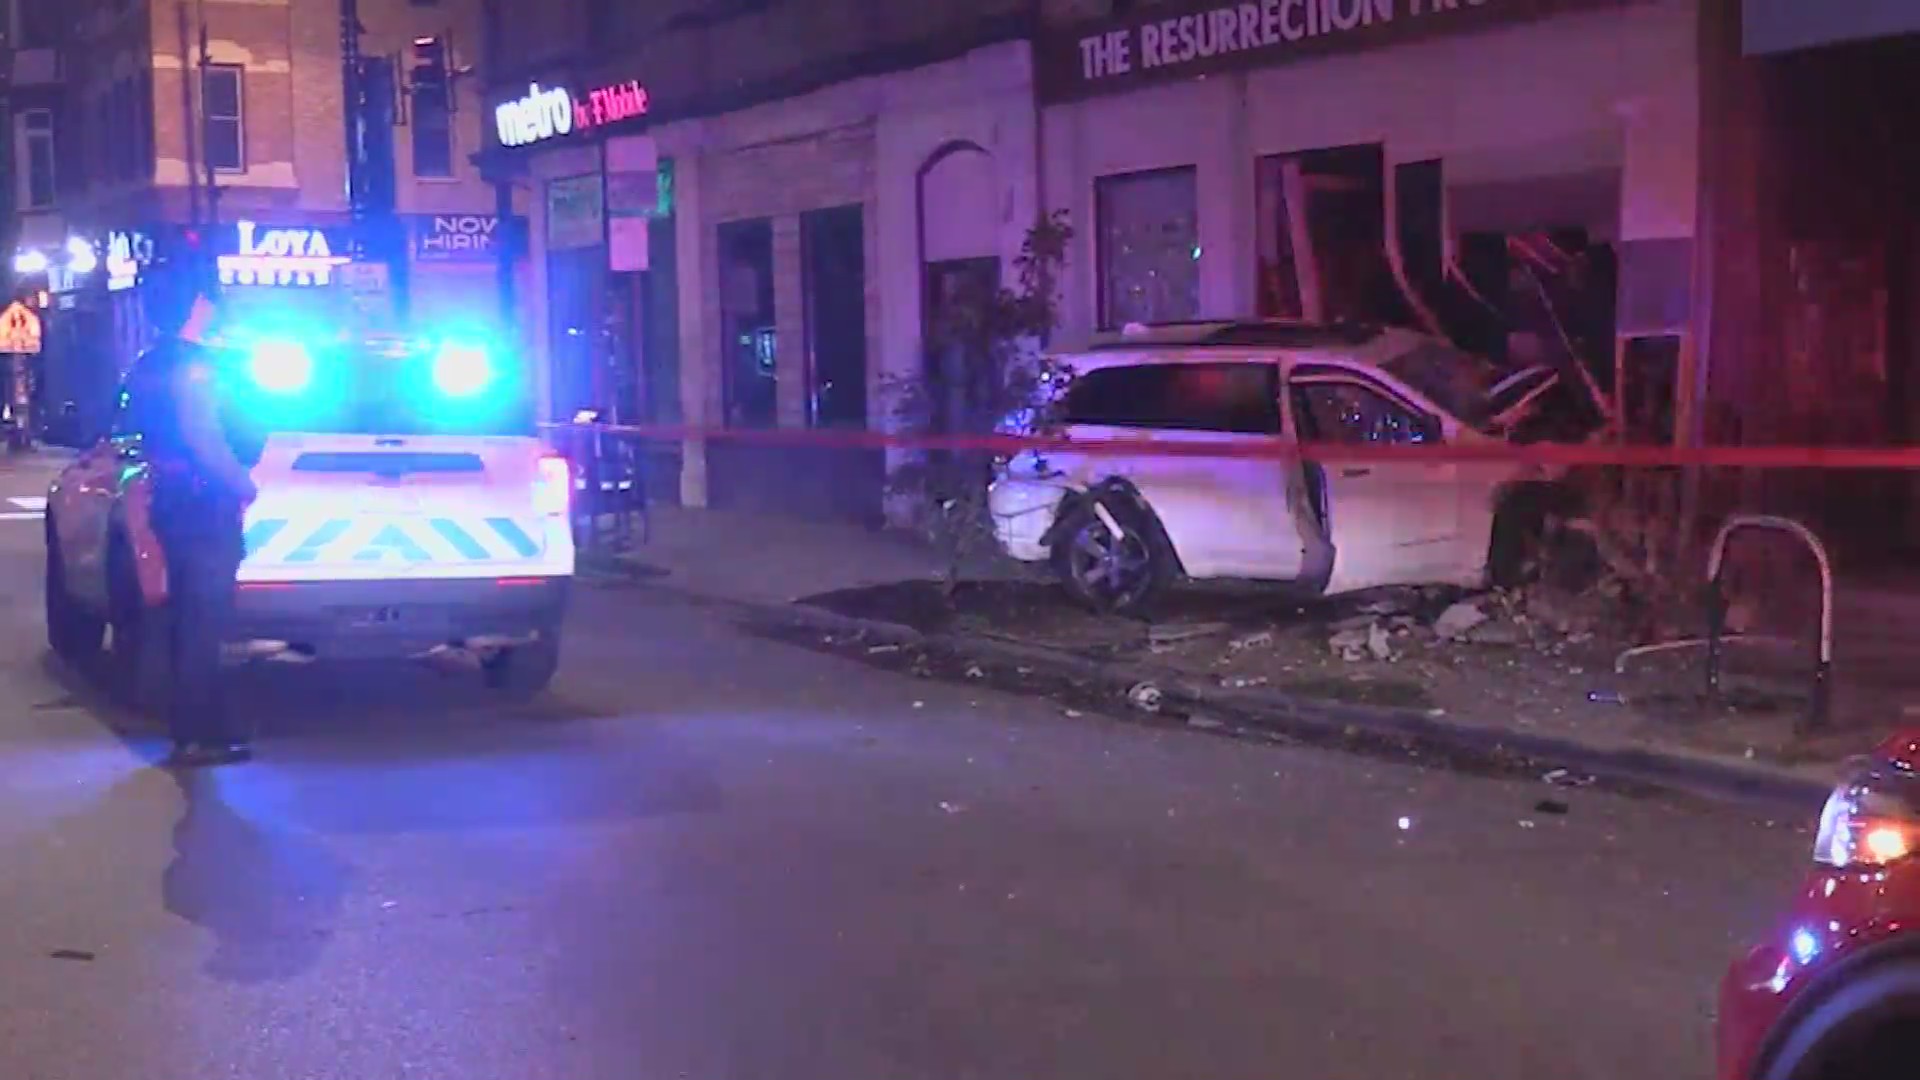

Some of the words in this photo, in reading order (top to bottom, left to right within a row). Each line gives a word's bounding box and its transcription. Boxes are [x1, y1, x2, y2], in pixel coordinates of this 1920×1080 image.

[1079, 30, 1131, 80] THE
[1140, 0, 1394, 69] RESURRECTION
[496, 82, 572, 146] metro
[237, 220, 332, 256] LOYA
